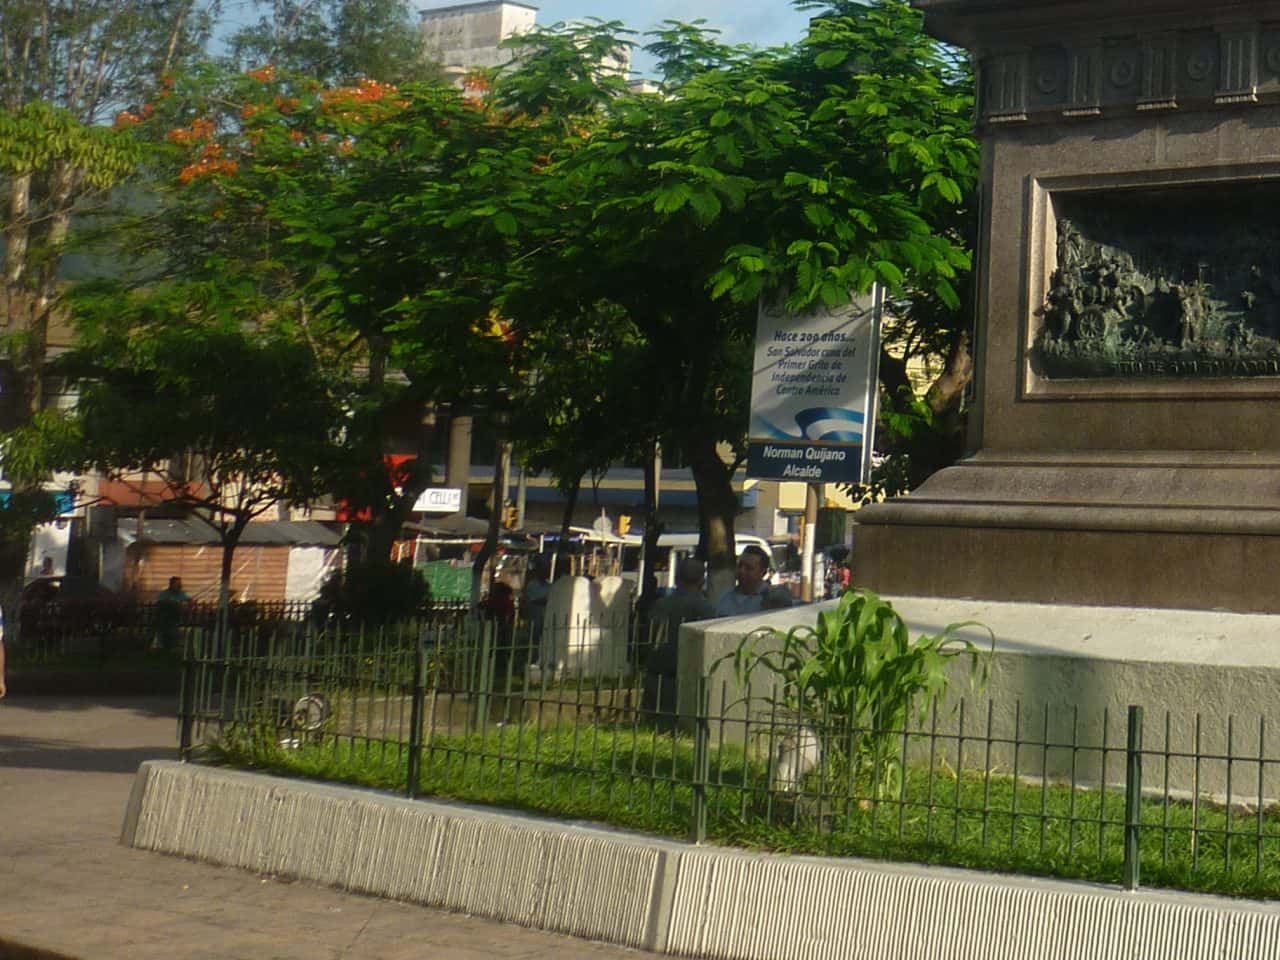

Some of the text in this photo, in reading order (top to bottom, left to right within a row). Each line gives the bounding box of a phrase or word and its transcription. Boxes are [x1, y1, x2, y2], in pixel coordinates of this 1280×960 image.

[774, 330, 797, 342] Hace
[799, 332, 819, 342] 200
[767, 346, 784, 357] San
[784, 346, 819, 357] Salvador
[842, 347, 856, 357] del
[778, 360, 843, 370] Primer Grito de
[771, 373, 847, 384] Independencia de
[776, 384, 841, 396] Centro América
[763, 445, 846, 463] Norman Quijano
[783, 464, 822, 478] Alcalde
